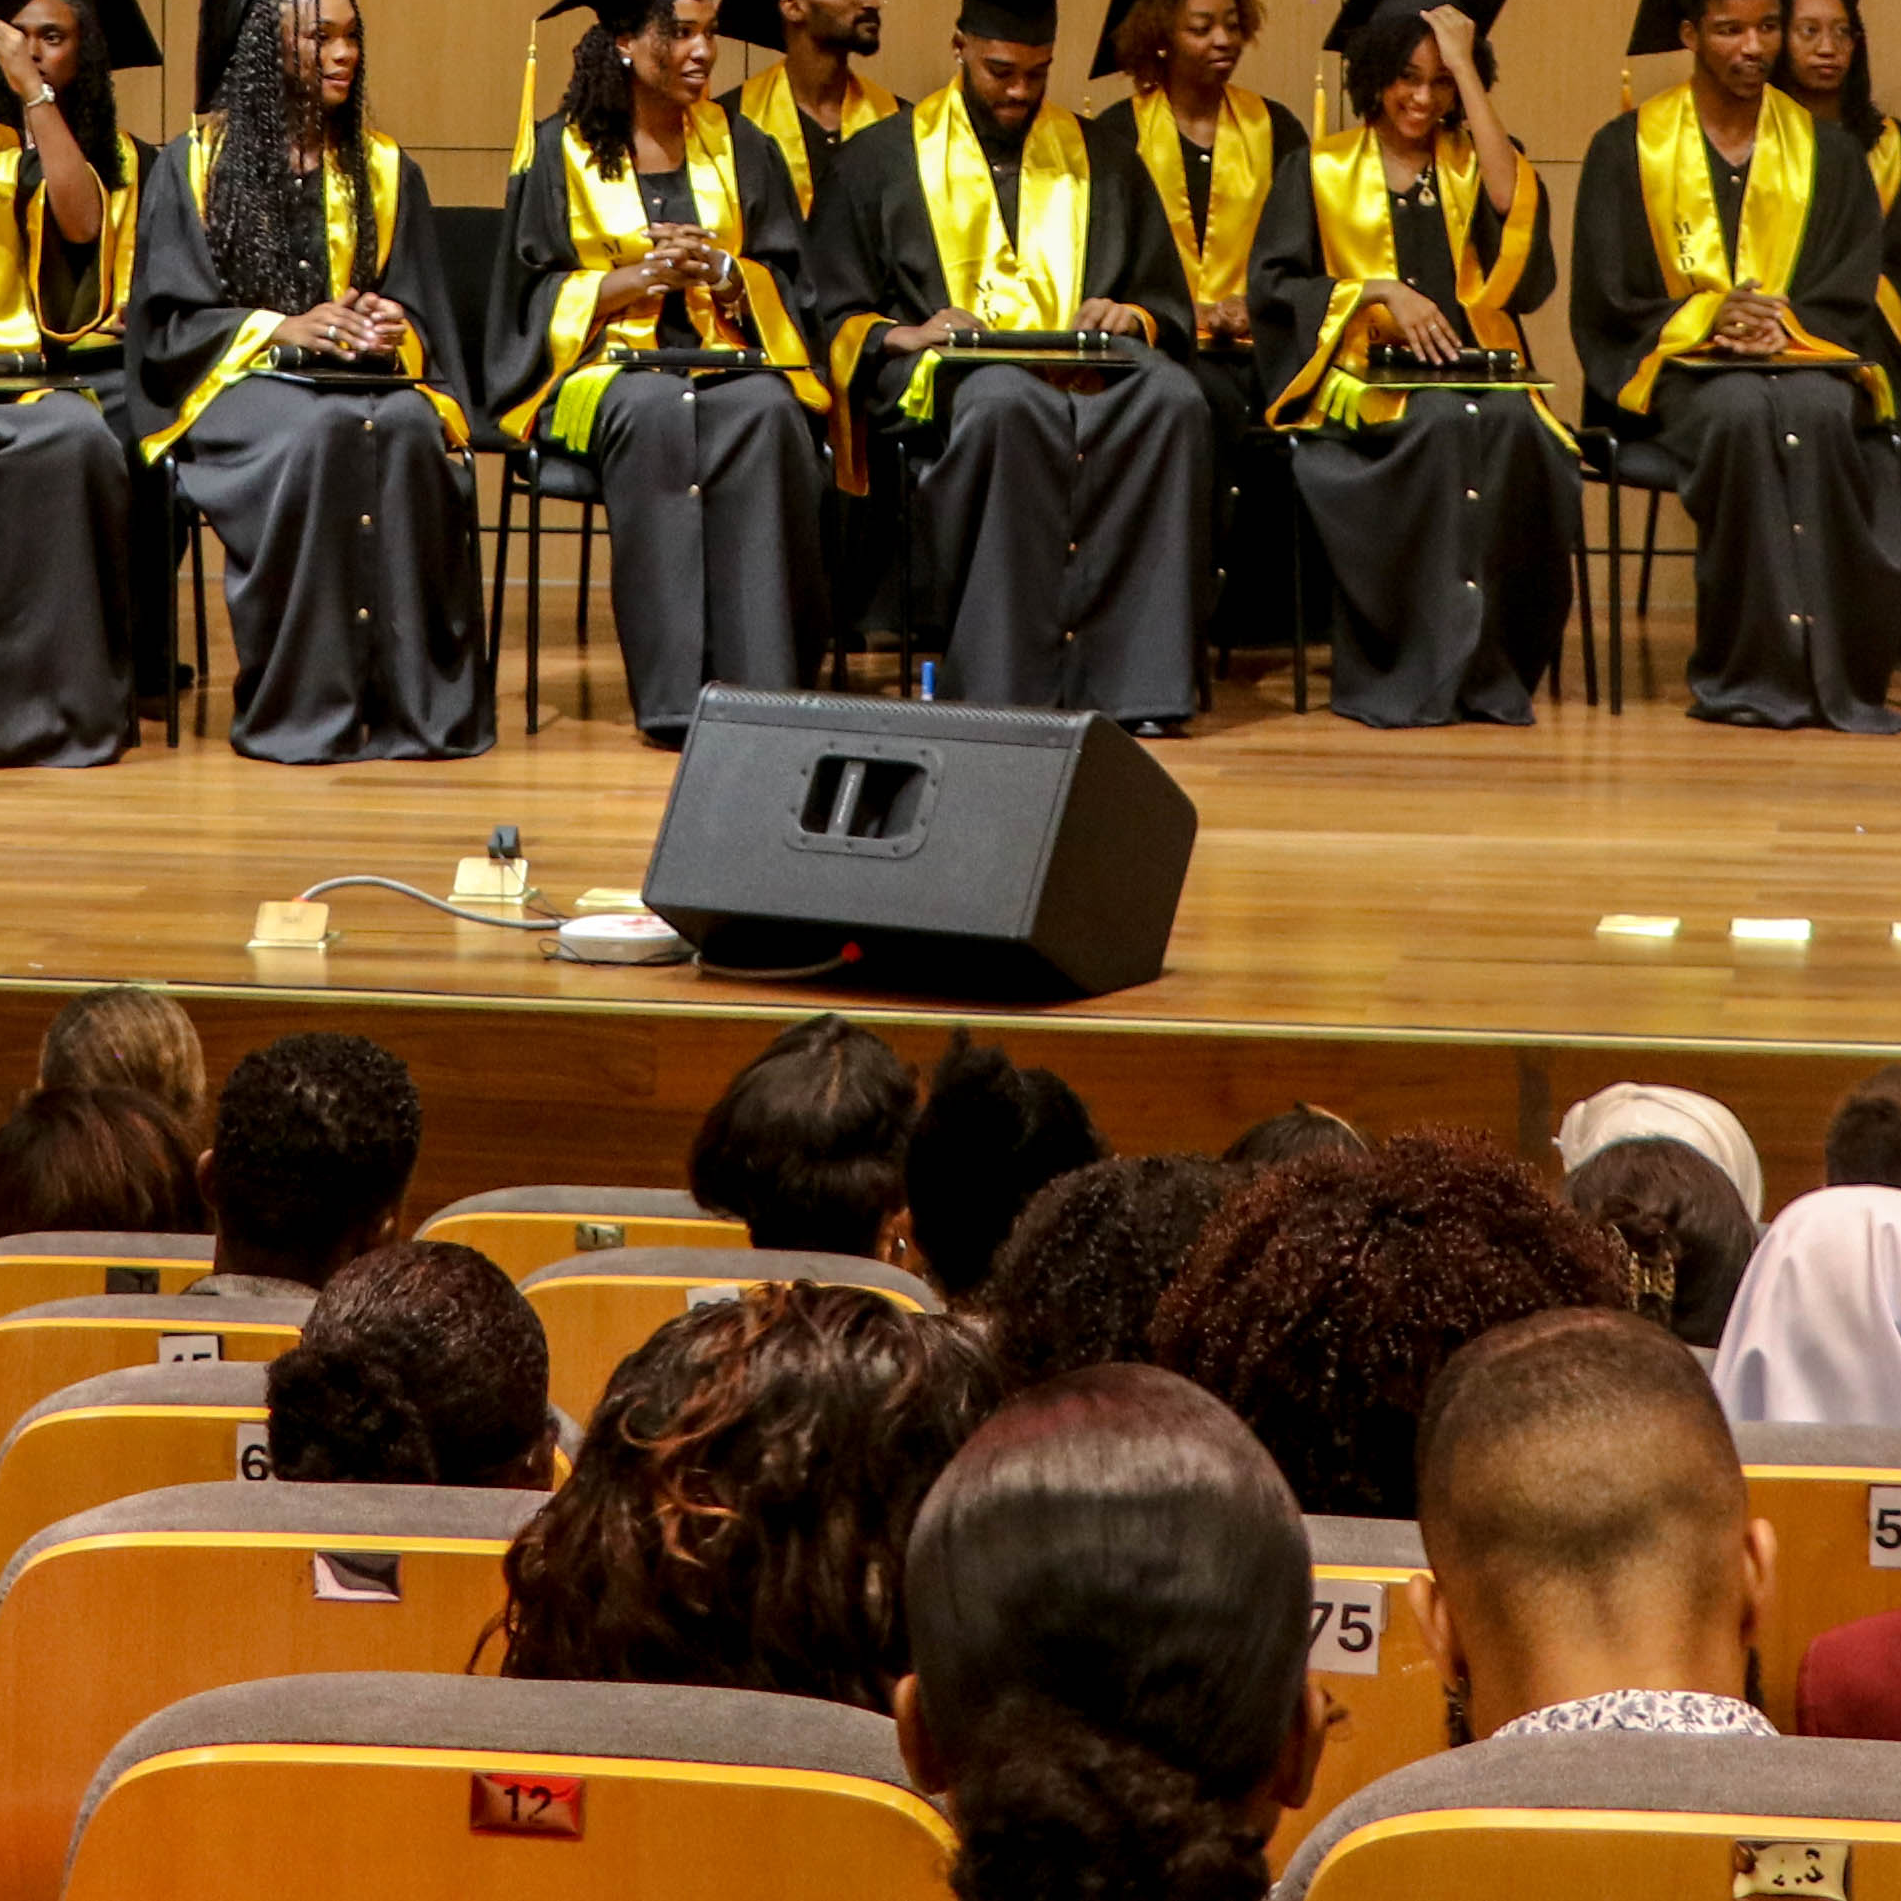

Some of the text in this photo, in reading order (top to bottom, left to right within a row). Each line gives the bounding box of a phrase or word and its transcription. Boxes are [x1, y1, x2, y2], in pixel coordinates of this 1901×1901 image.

[241, 1444, 270, 1481] 6
[1308, 1602, 1373, 1652] 75
[504, 1784, 552, 1823] 12
